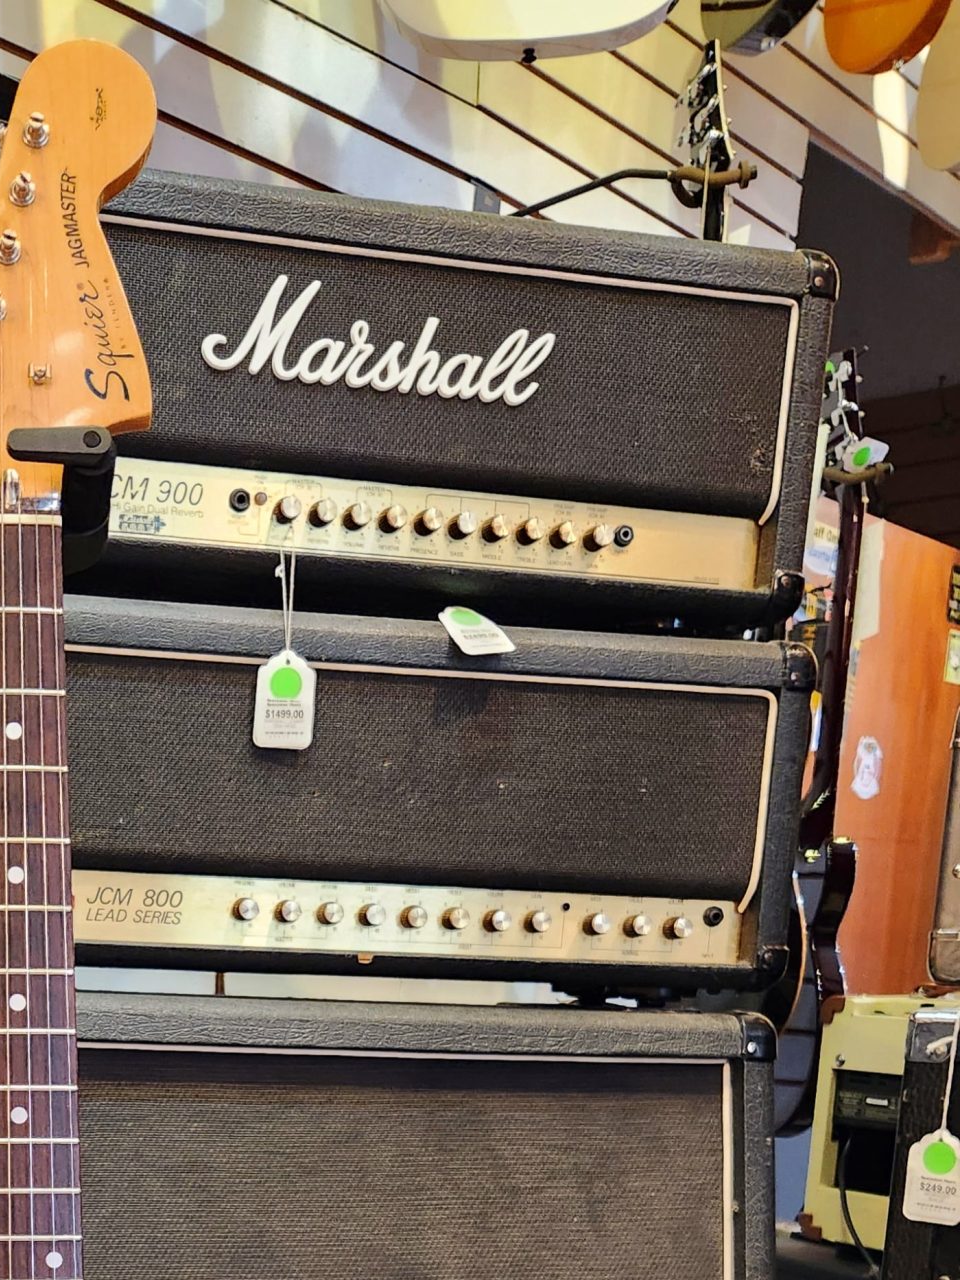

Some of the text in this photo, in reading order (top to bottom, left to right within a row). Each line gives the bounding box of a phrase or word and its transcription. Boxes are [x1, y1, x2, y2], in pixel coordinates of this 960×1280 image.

[60, 172, 90, 268] JAGMASTER
[80, 279, 135, 402] Squier
[200, 274, 557, 407] Marshall
[110, 474, 204, 506] CM 900
[123, 502, 146, 513] Gain
[147, 504, 169, 515] Dual
[171, 506, 204, 519] Reverb
[265, 709, 304, 719] $1499.00
[86, 886, 184, 909] JCM 800
[85, 908, 183, 926] LEAD SERIES
[919, 1181, 957, 1196] $249.00
